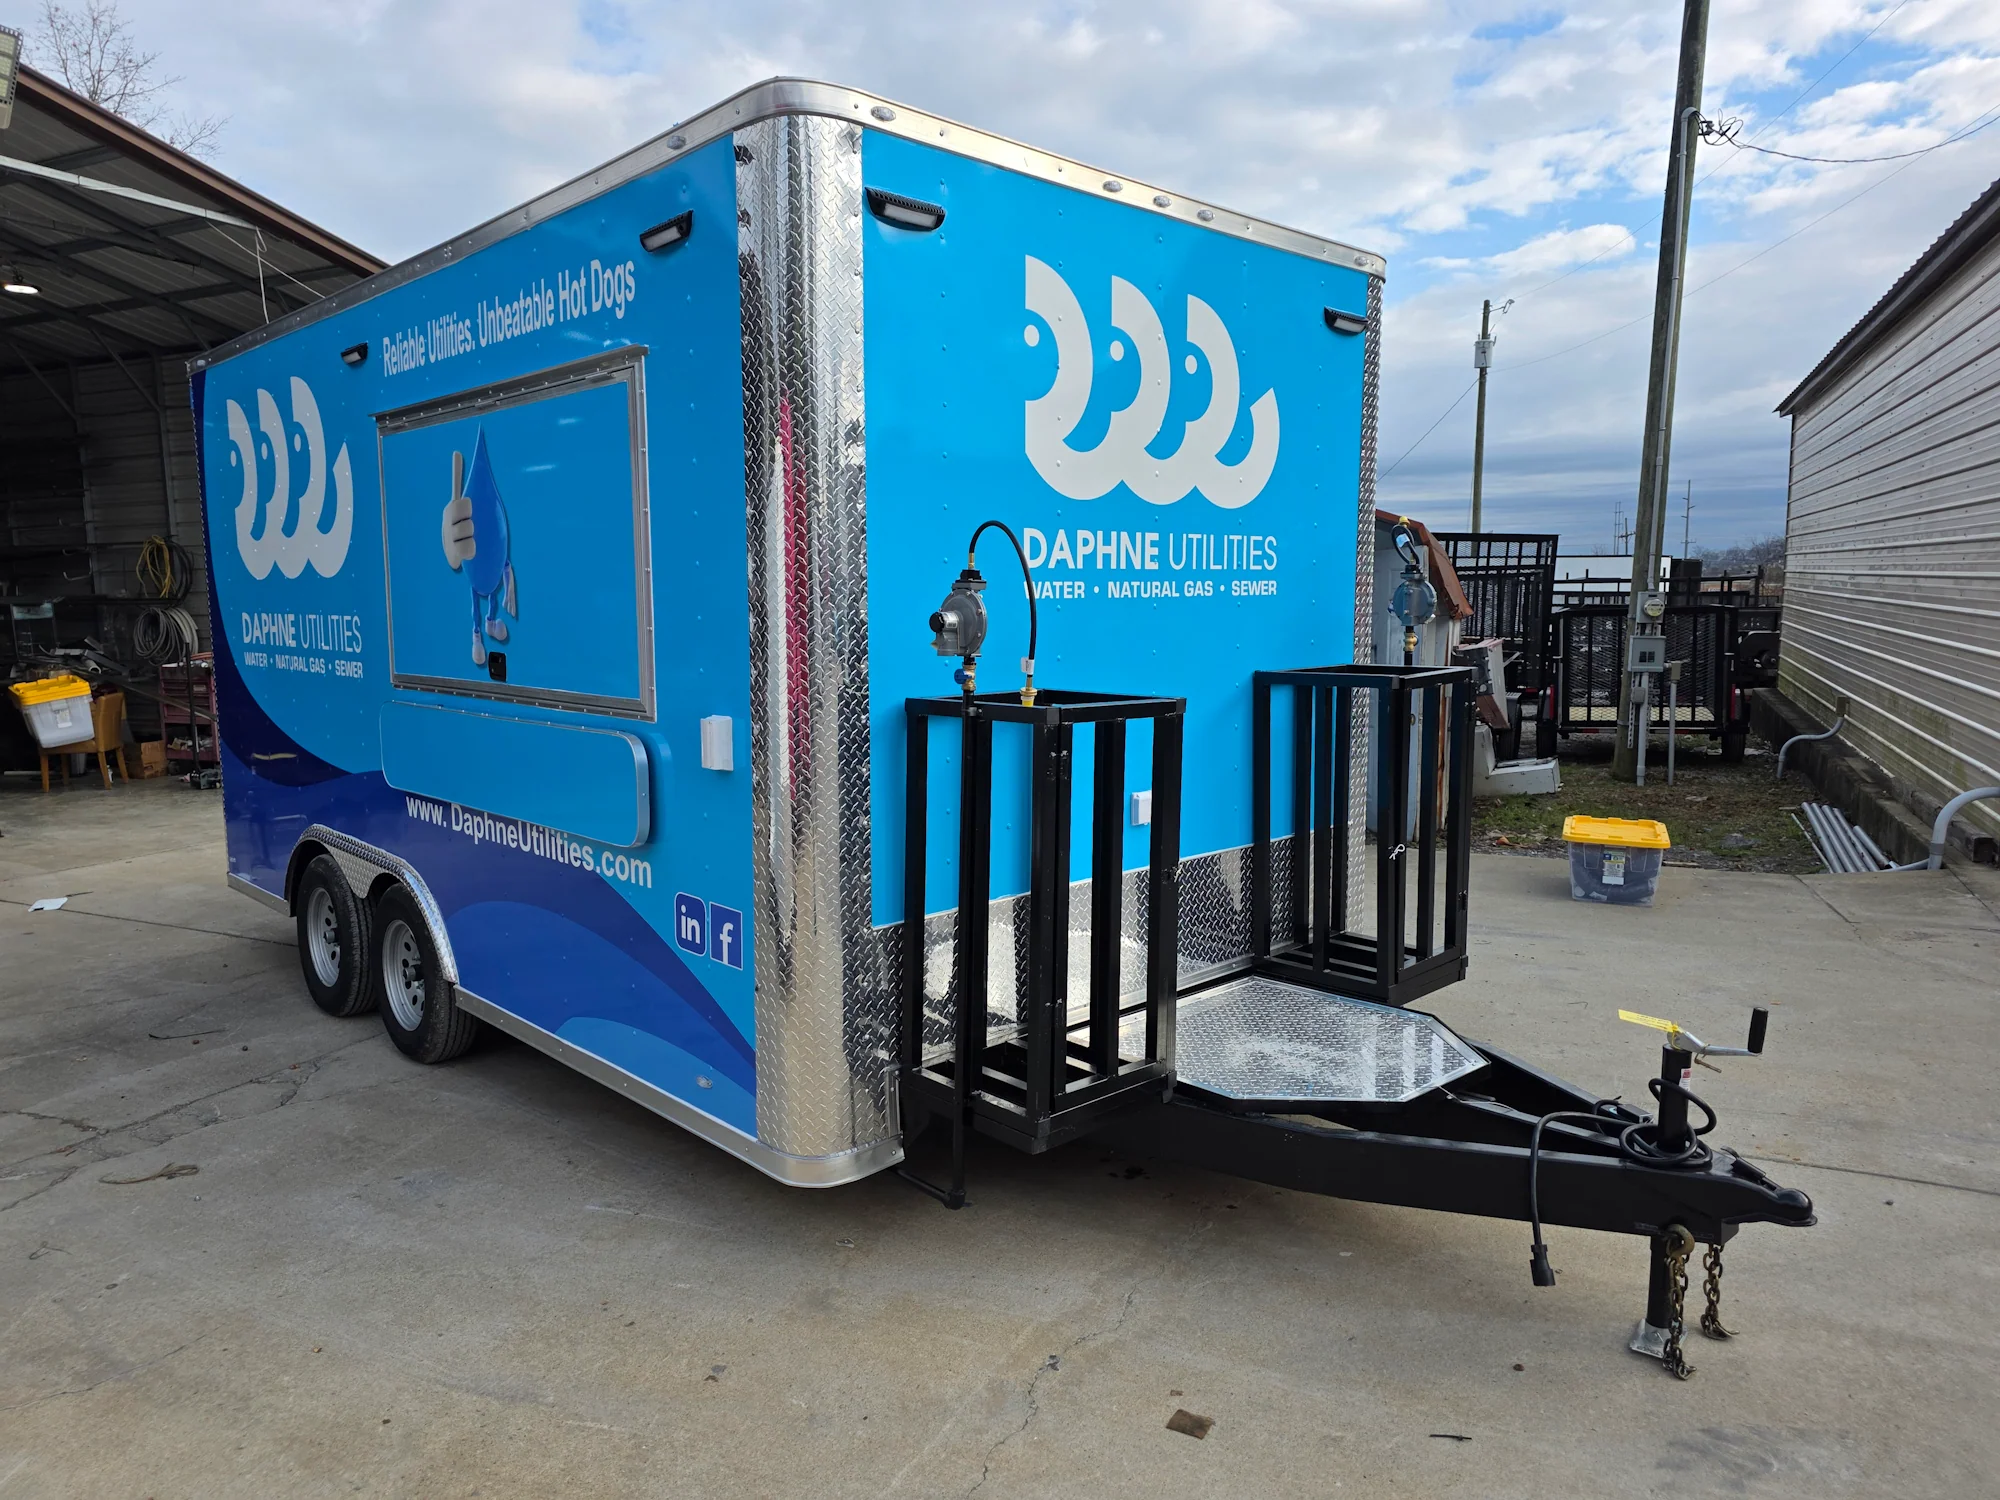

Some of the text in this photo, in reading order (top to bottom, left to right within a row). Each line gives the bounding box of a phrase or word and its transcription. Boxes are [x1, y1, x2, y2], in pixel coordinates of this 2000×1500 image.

[383, 259, 636, 377] Reliable Utilities. Unbeatable Hot Dogs
[1023, 527, 1278, 571] DAPHNE UTILITIES
[1107, 581, 1180, 598] NATURAL
[1184, 580, 1213, 597] GAS
[1231, 580, 1278, 596] SEWER
[241, 612, 362, 654] DAPHNE UTILITIES
[243, 652, 363, 678] WATER NATURAL GAS SEWER
[406, 795, 653, 889] www. DaphneUtilities.com
